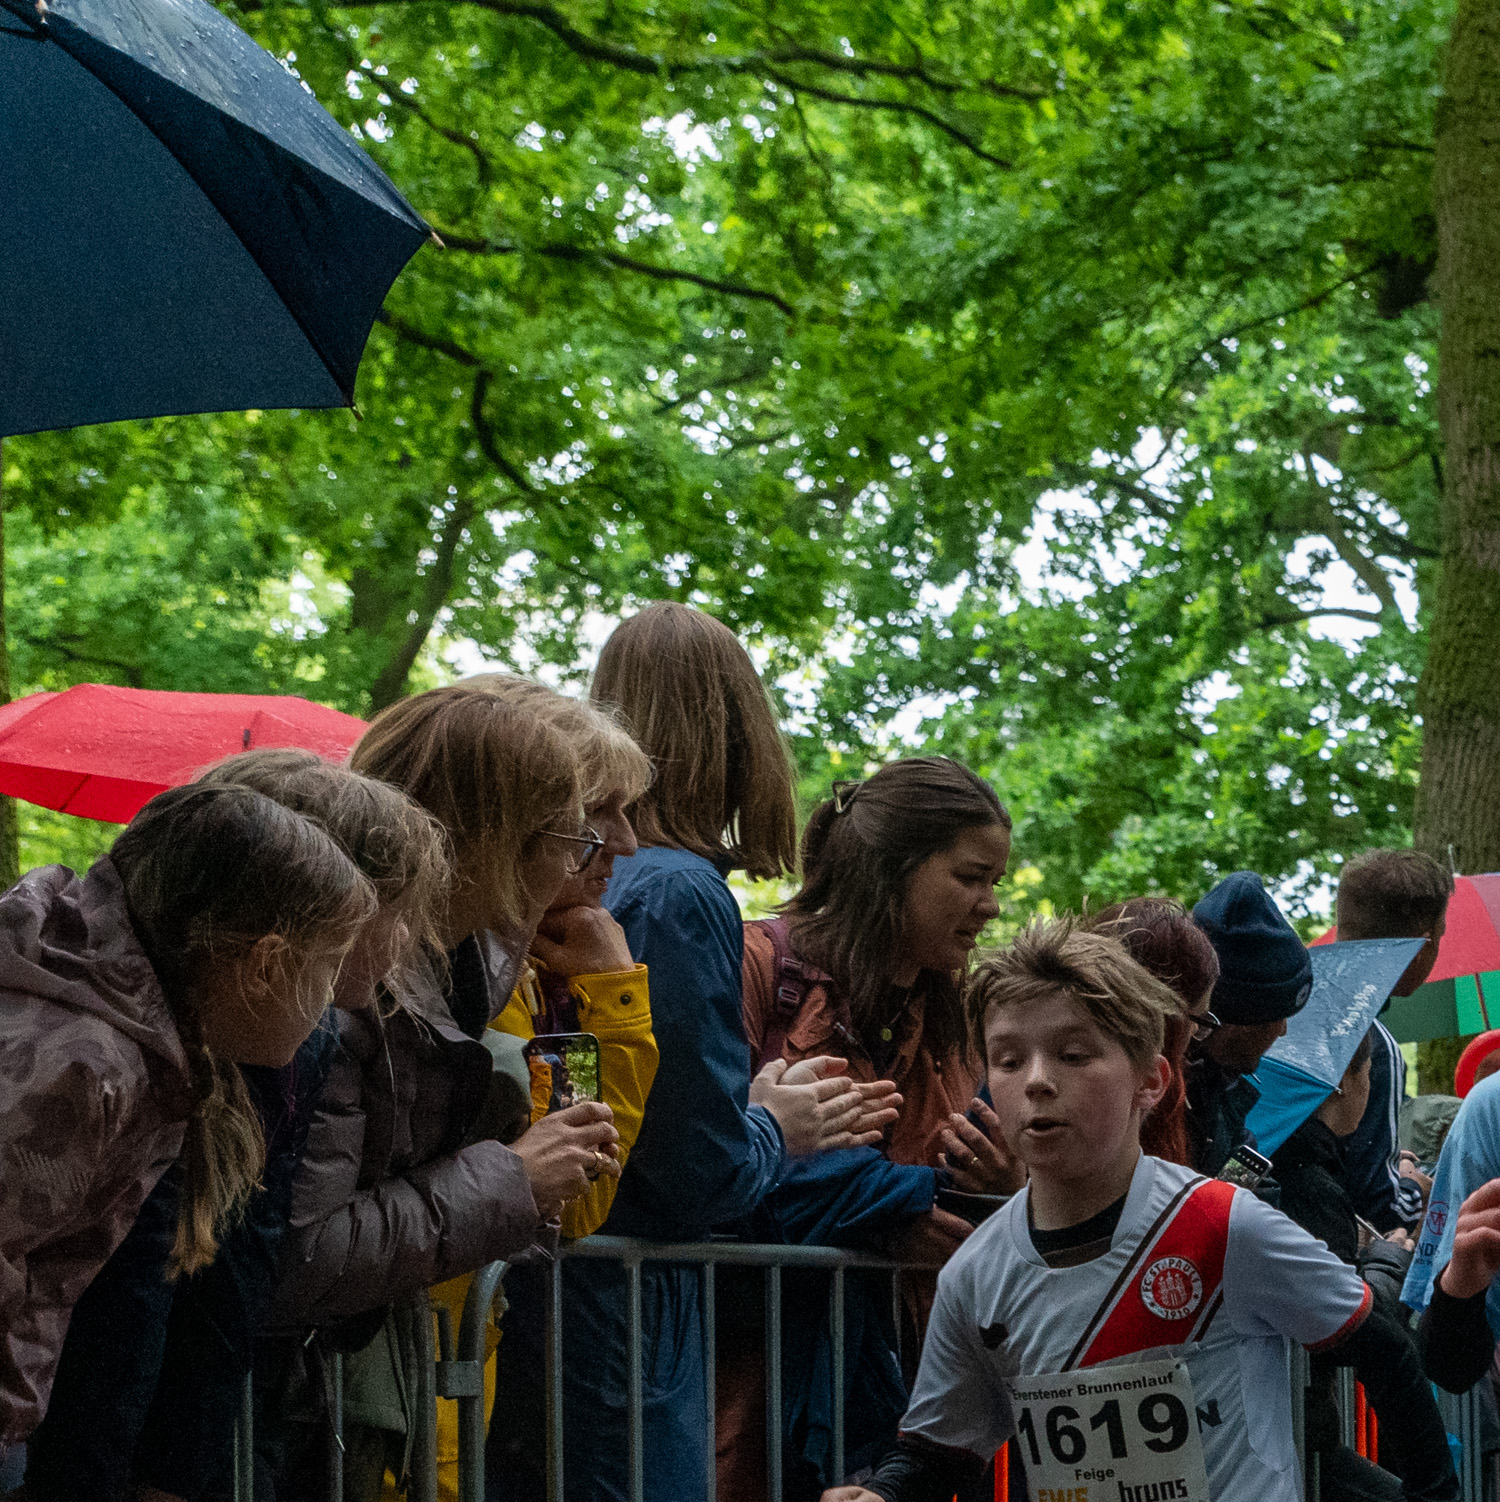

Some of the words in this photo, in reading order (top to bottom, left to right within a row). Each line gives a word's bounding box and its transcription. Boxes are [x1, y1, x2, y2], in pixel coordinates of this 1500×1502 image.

[1168, 1258, 1201, 1284] PAULI
[1077, 1372, 1175, 1397] Brunnenlauf
[1018, 1392, 1190, 1466] 1619
[1074, 1467, 1116, 1482] Feige
